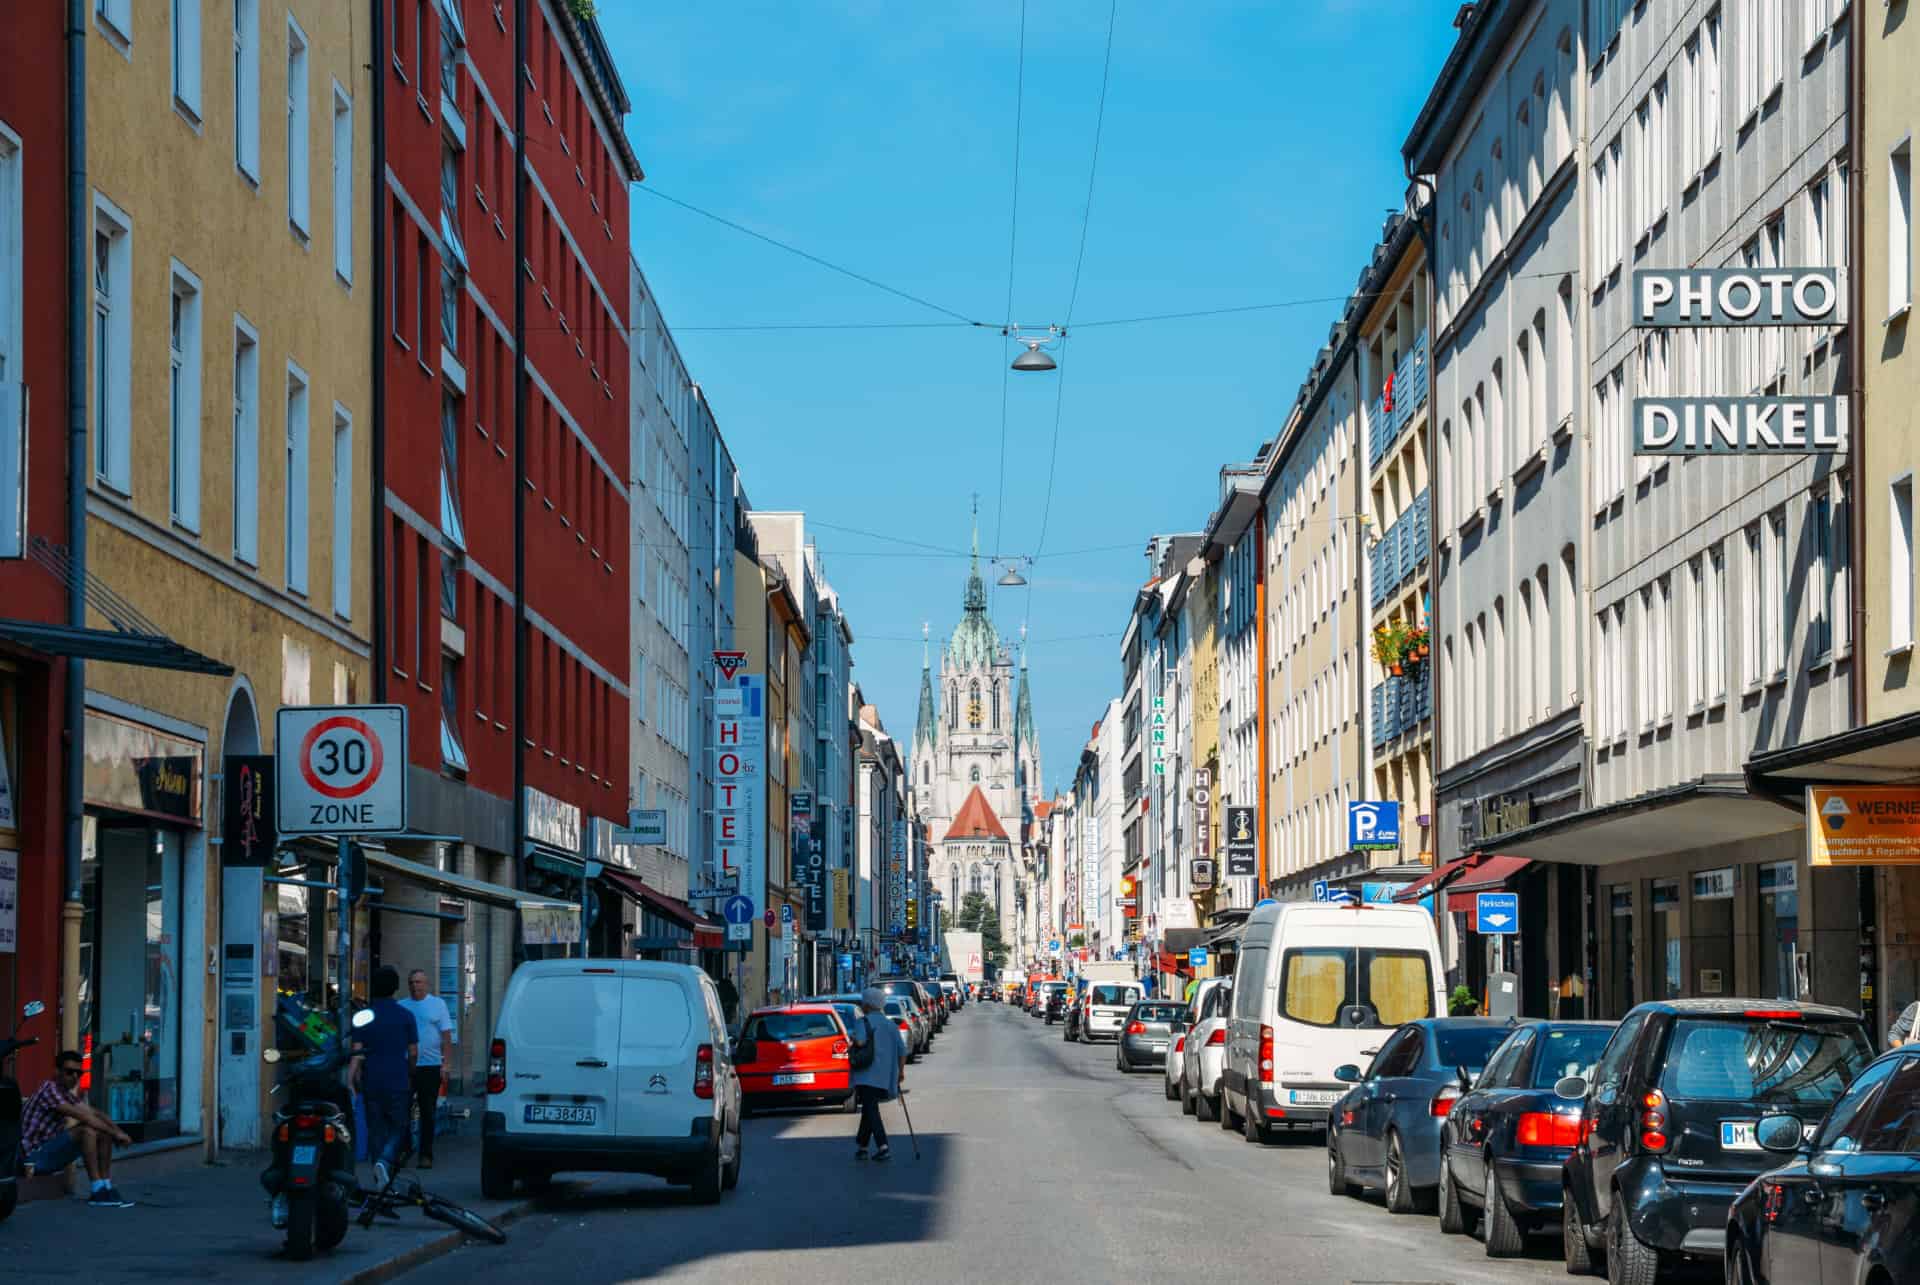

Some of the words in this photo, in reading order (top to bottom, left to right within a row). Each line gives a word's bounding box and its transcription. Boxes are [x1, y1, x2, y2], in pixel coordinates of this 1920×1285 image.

[1642, 273, 1837, 319] PHOTO
[1642, 403, 1838, 449] DINKEL
[318, 739, 366, 776] 30
[1153, 697, 1165, 775] HANIN
[310, 804, 375, 825] ZONE
[718, 721, 740, 870] HOTEL
[1195, 772, 1209, 857] HOTEL
[1355, 811, 1377, 841] P
[809, 839, 823, 914] HOTEL
[1315, 884, 1324, 901] P
[1734, 1126, 1746, 1143] M
